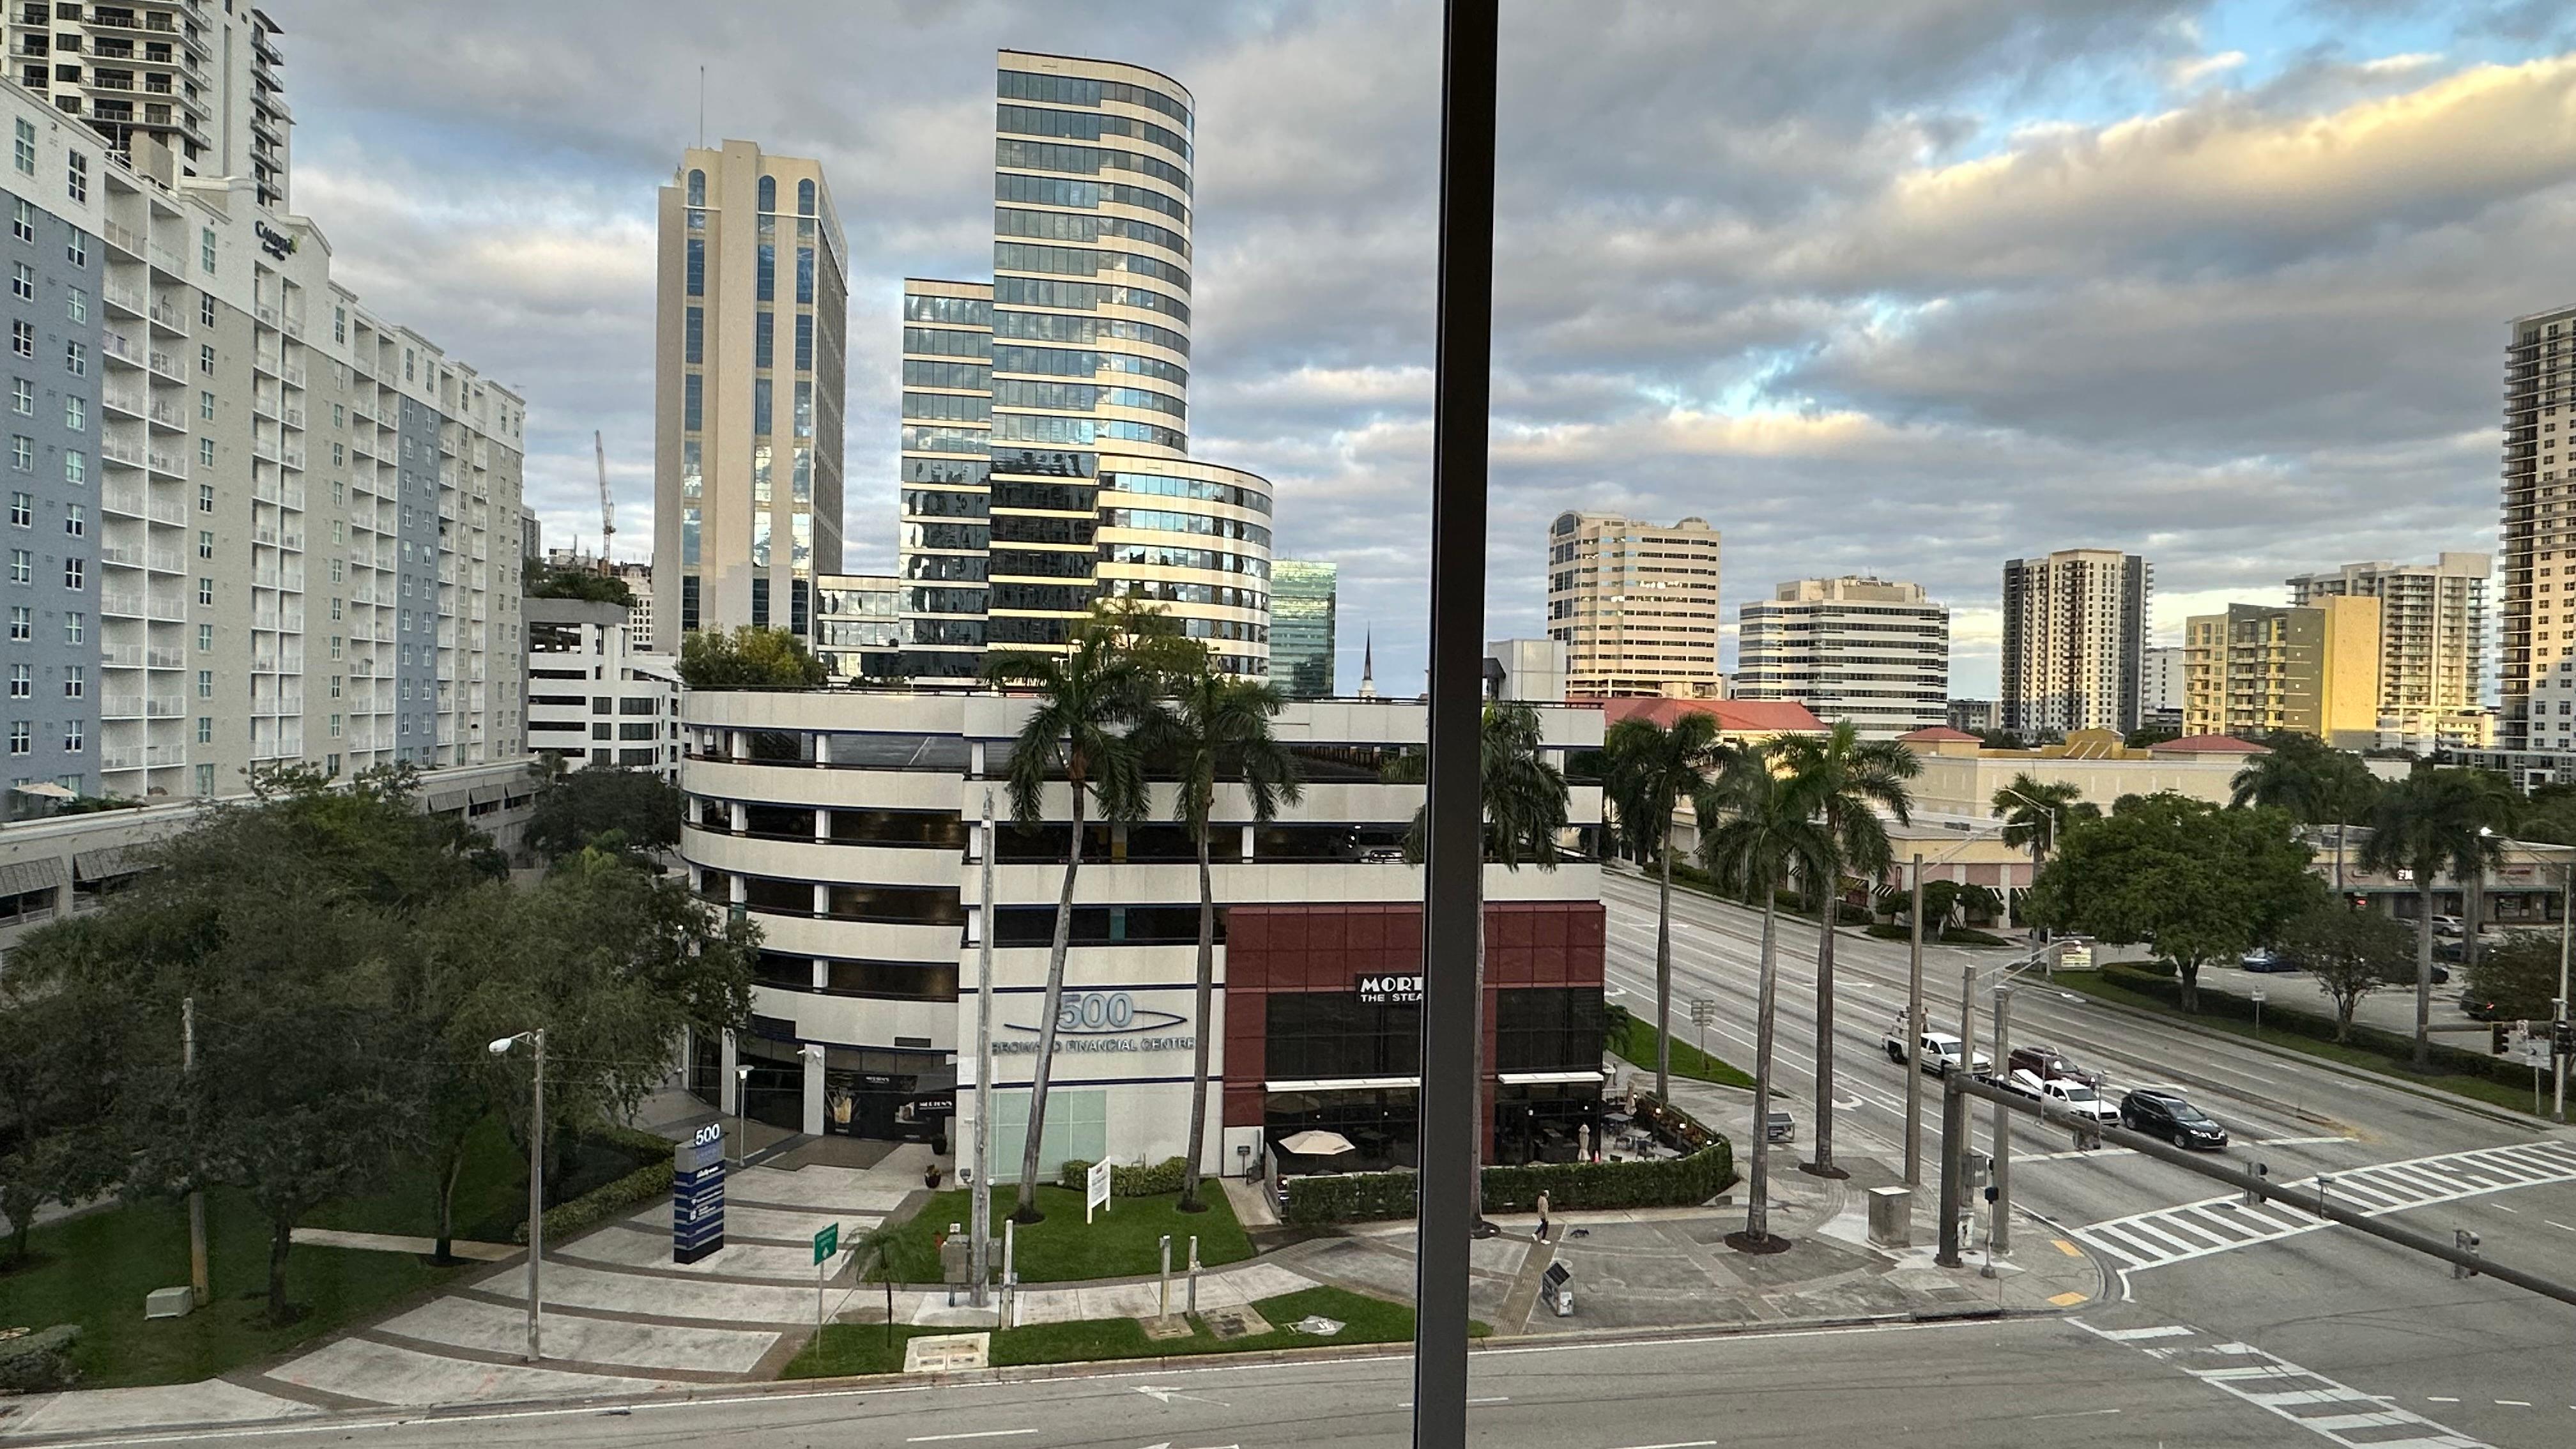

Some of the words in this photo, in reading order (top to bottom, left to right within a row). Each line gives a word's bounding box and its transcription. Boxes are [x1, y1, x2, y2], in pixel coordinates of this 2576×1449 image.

[1057, 993, 1133, 1029] 500
[992, 1041, 1062, 1054] BROWAD
[1066, 1039, 1137, 1053] FINANCIAL
[1140, 1037, 1195, 1051] CENTRE
[696, 1123, 719, 1146] 500
